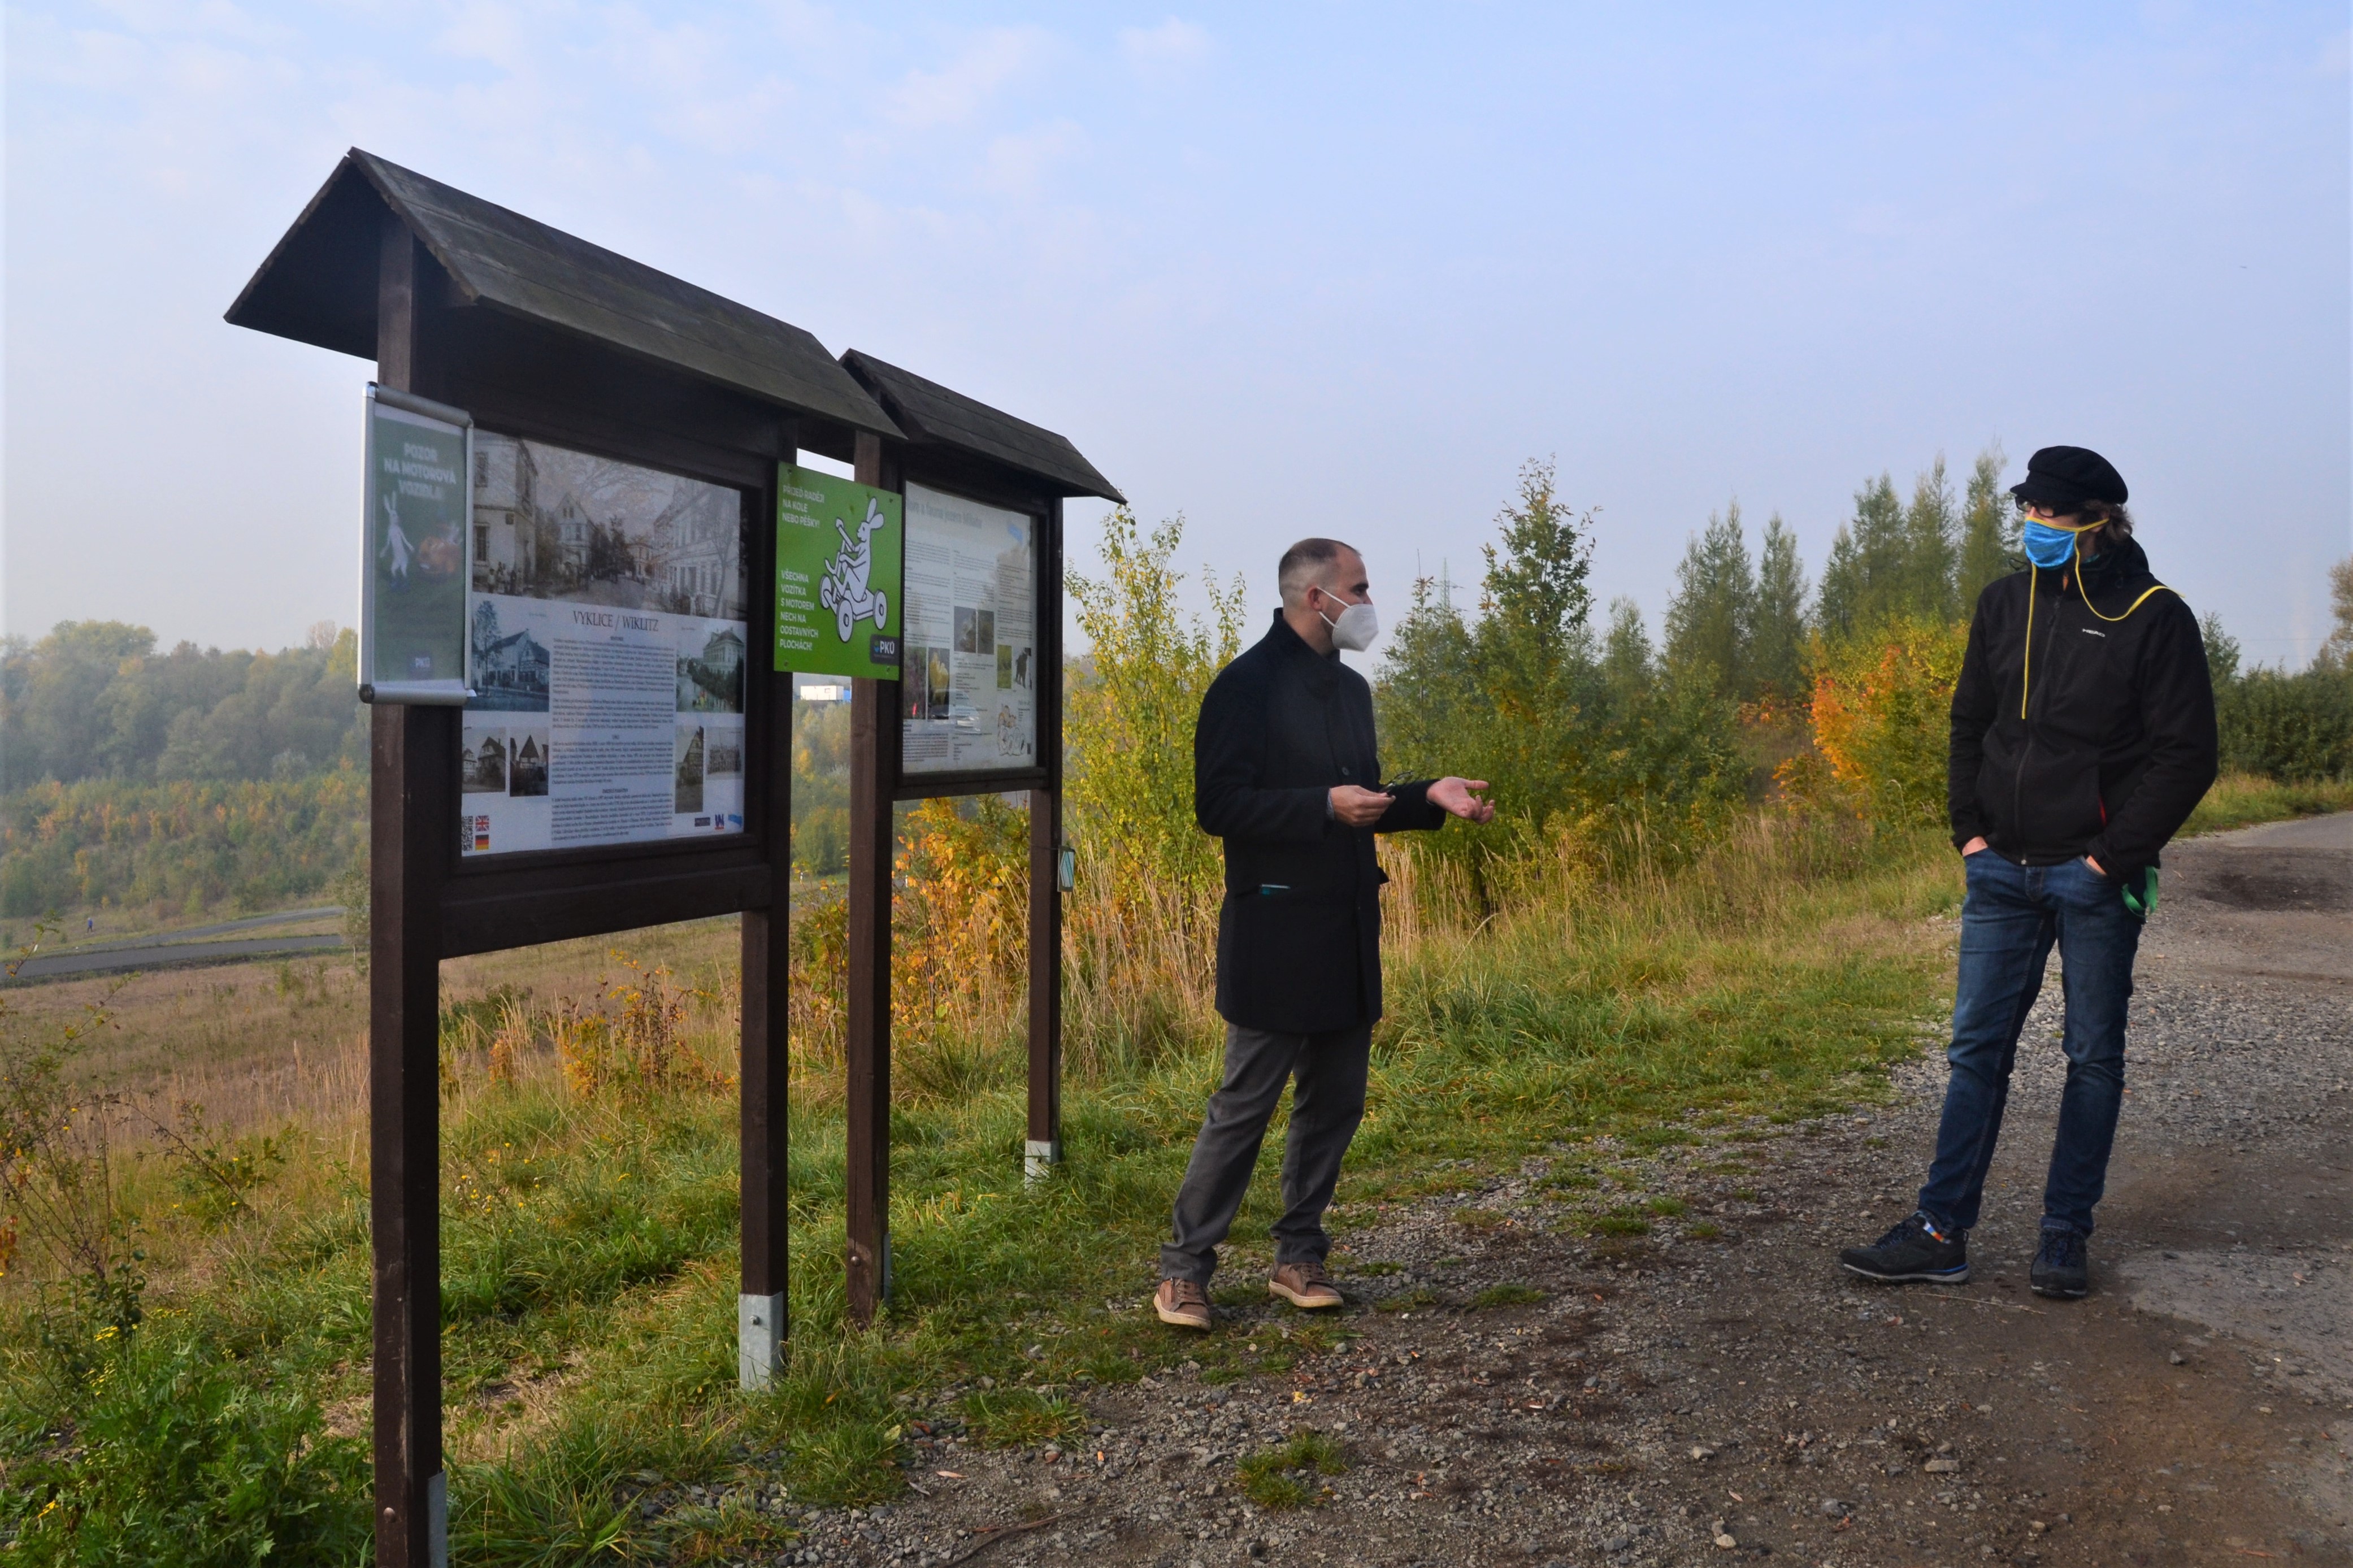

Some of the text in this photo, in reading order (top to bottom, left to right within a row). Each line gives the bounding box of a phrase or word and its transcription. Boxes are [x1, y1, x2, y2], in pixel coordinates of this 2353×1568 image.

[384, 457, 400, 474] NA
[782, 498, 808, 512] NA KOLE
[782, 512, 799, 524] NEBO
[781, 569, 809, 583] VŠECHNA
[781, 584, 806, 597] VOZÍTKA
[780, 598, 815, 611] S MOTOREM
[573, 611, 613, 627] VYKLICE
[623, 615, 659, 632] WIKLITZ
[780, 611, 806, 623] NECH NA
[780, 625, 819, 639] ODSTAVNÝCH
[2082, 628, 2105, 637] HEAD
[780, 639, 813, 651] PLOCHÁCH!
